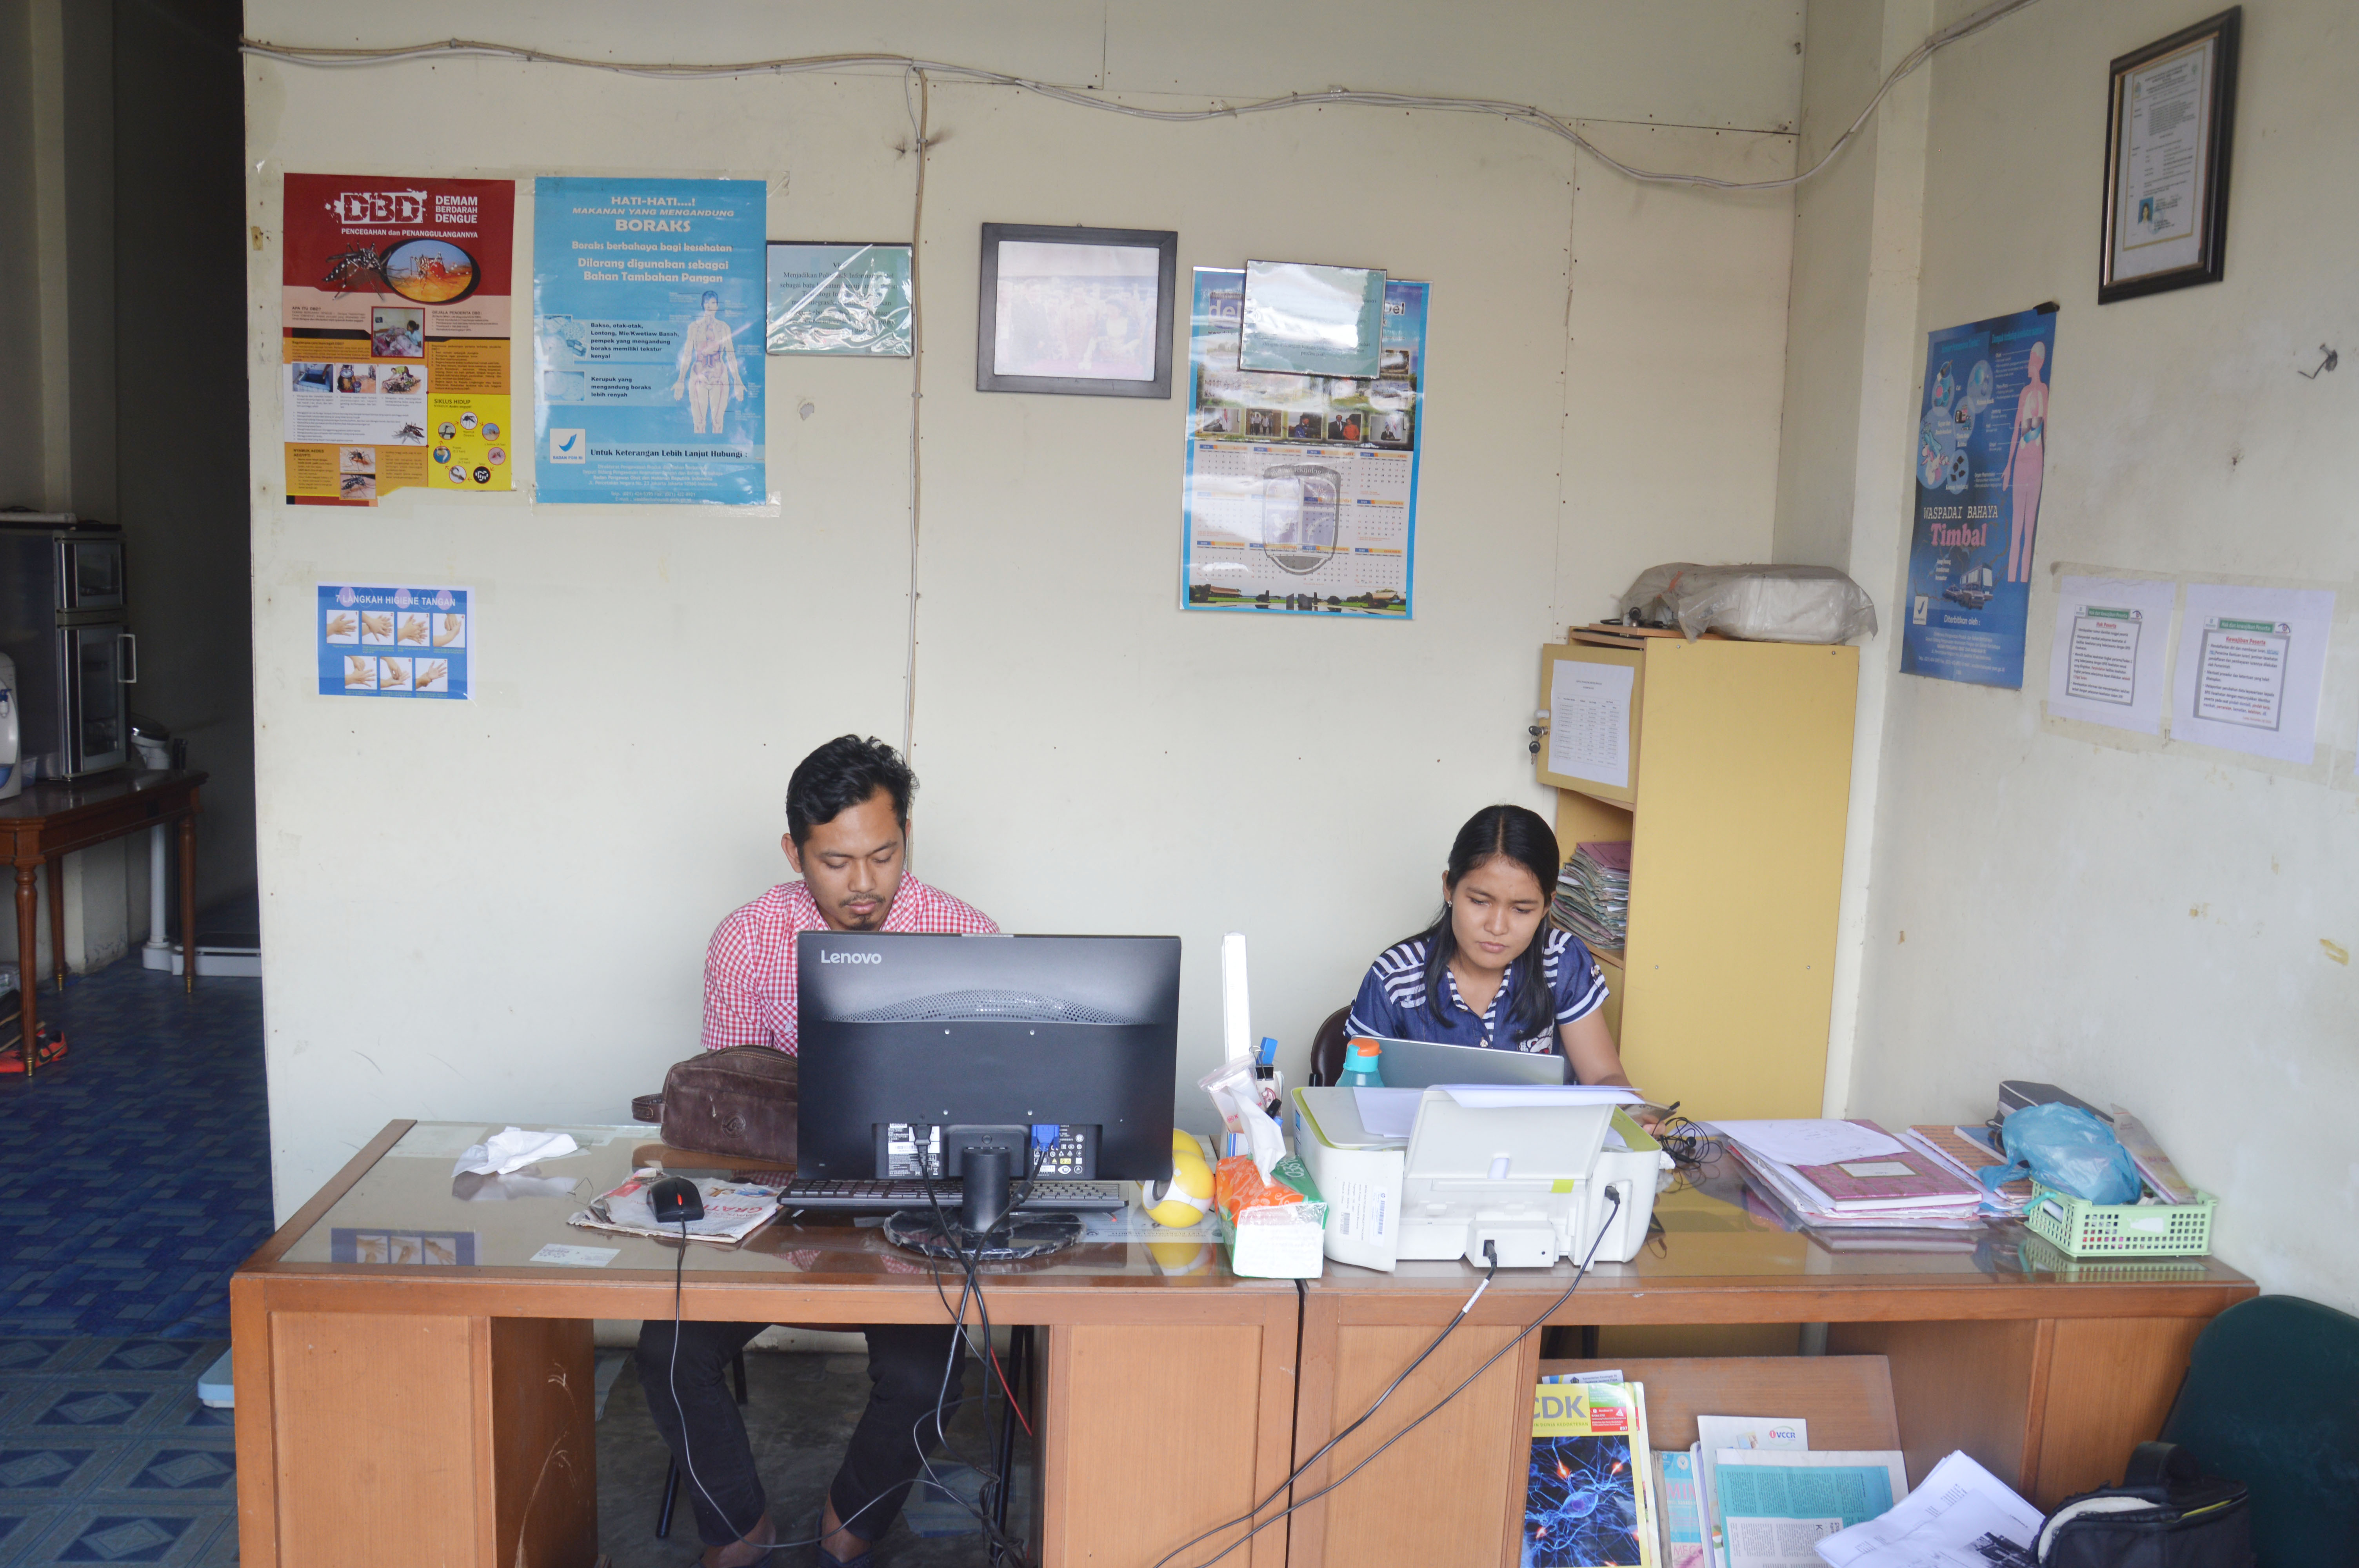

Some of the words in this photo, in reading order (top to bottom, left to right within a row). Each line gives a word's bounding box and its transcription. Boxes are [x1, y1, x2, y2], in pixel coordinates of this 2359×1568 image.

[436, 196, 477, 206] DEMAM
[344, 194, 421, 222] DBD
[436, 214, 477, 223] DENGUE
[615, 220, 691, 232] BORAKS
[572, 241, 604, 249] Boraks
[607, 241, 658, 252] berbahaya
[660, 243, 681, 252] bagi
[684, 243, 732, 252] kesehatan
[578, 258, 624, 269] Dilarang
[627, 259, 685, 270] digunakan
[688, 260, 729, 270] sebagai
[584, 272, 618, 281] Bahan
[622, 272, 678, 282] Tambahan
[682, 273, 723, 284] Pangan
[1209, 299, 1242, 319] del
[615, 449, 660, 457] Keterangan
[662, 449, 682, 457] Lebih
[684, 449, 709, 458] Lanjut
[711, 450, 743, 458] Hubungi
[1924, 506, 1963, 519] WASPADAI
[1967, 506, 1998, 518] BAHAYA
[1931, 523, 1987, 547] Timbal
[343, 595, 383, 604] LANGKAH
[386, 596, 419, 605] HIGIENE
[421, 597, 456, 606] TANGAN
[1944, 615, 1968, 624] Diterbitkan
[821, 950, 881, 964] Lenovo
